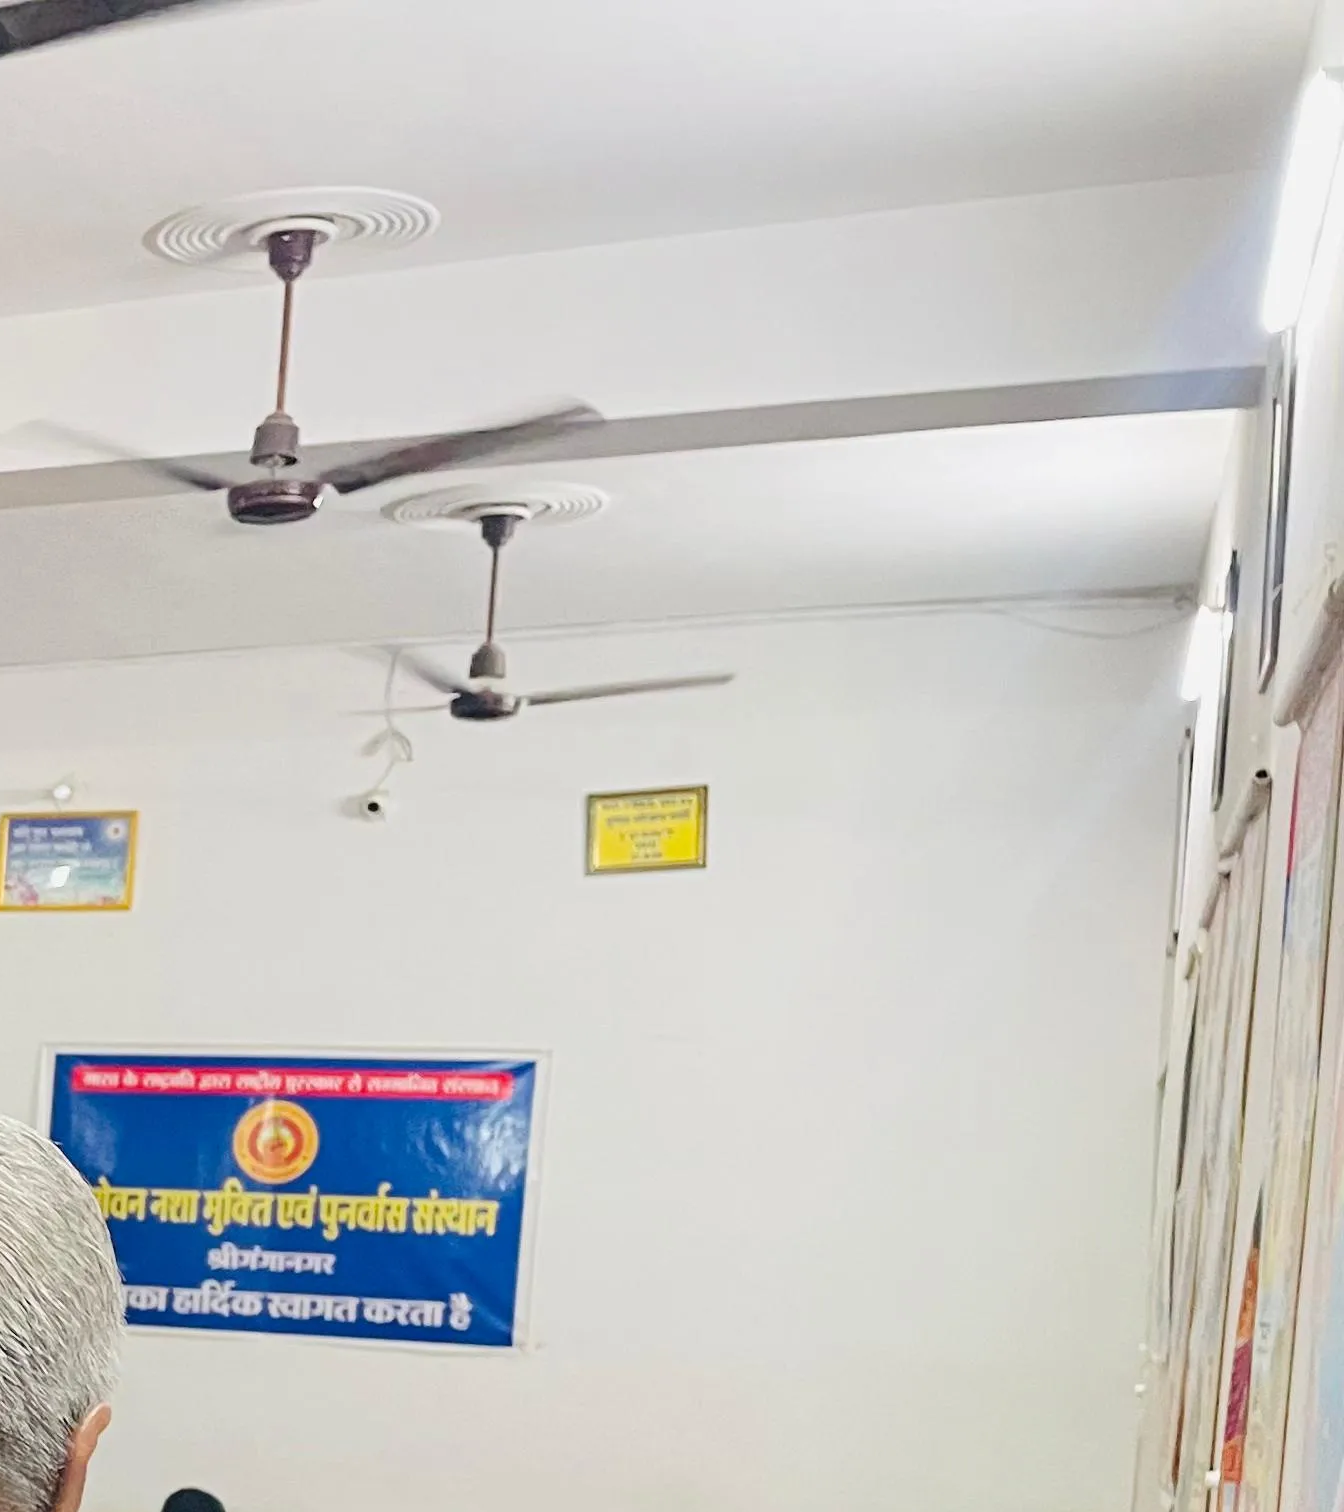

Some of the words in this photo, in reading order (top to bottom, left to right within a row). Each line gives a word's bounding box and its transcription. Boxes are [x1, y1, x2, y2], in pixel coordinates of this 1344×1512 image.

[150, 1188, 201, 1224] नशा
[203, 1177, 273, 1236] मुक्ति
[276, 1185, 318, 1229] एवं
[319, 1182, 409, 1240] पुनर्वास
[412, 1189, 500, 1237] संस्थान
[206, 1241, 337, 1275] श्रीगंगानगर
[172, 1279, 263, 1318] हार्दिक
[267, 1290, 359, 1323] स्वागत
[362, 1296, 446, 1328] करता
[448, 1292, 473, 1332] है
